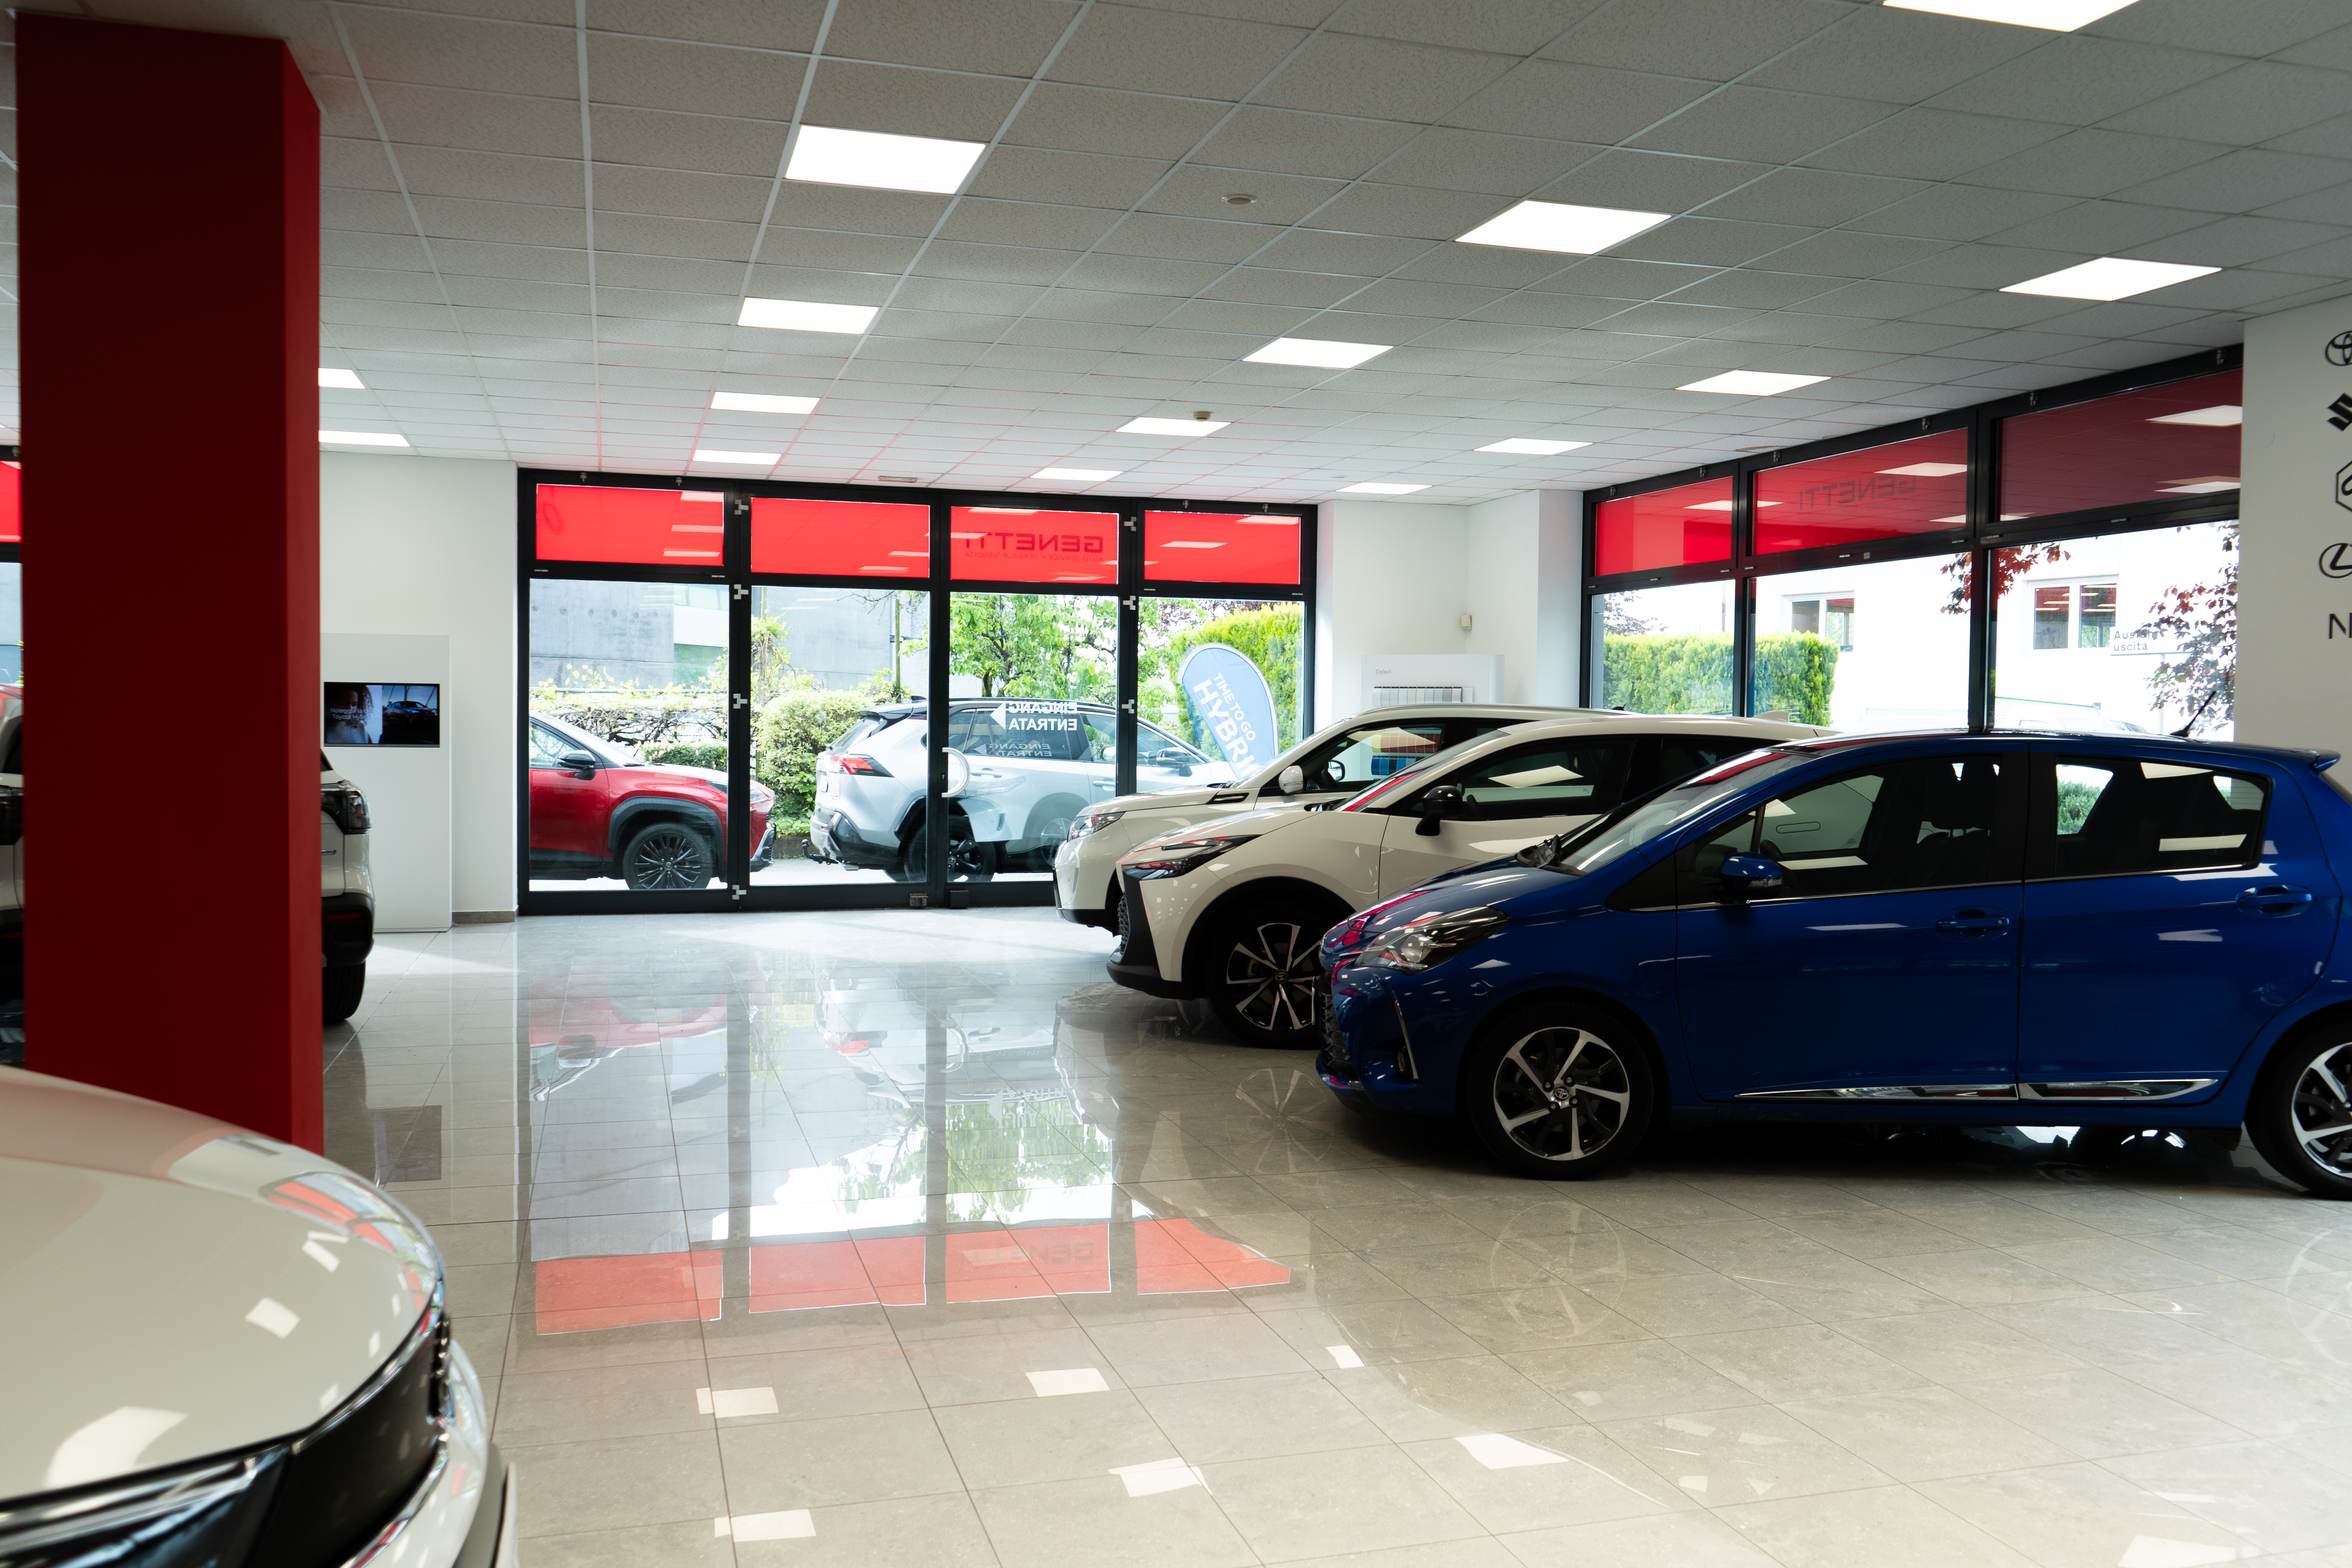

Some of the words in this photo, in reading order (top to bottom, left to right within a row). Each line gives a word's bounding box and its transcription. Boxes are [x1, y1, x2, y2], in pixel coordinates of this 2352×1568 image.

[2114, 641, 2147, 651] uscita
[1213, 672, 1235, 704] TIME
[1230, 702, 1245, 720] TO
[1240, 721, 1256, 741] GO
